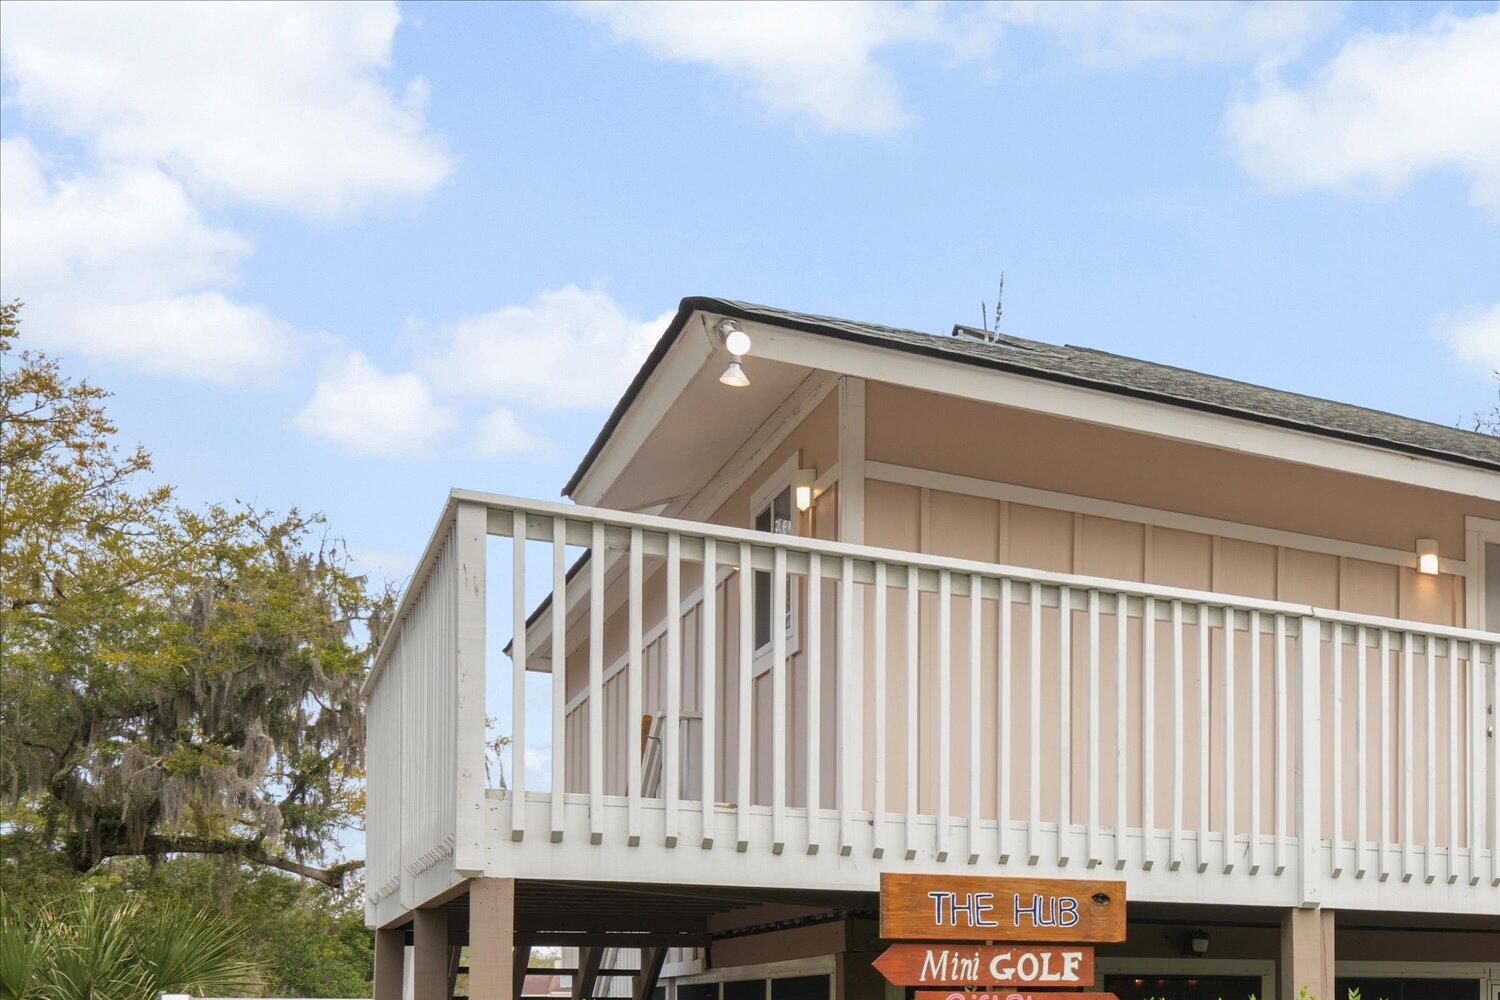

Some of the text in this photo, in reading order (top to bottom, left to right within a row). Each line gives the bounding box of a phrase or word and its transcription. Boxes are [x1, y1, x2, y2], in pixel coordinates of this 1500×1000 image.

[928, 891, 1079, 928] THE HUB
[919, 950, 1083, 982] Mini GOLF
